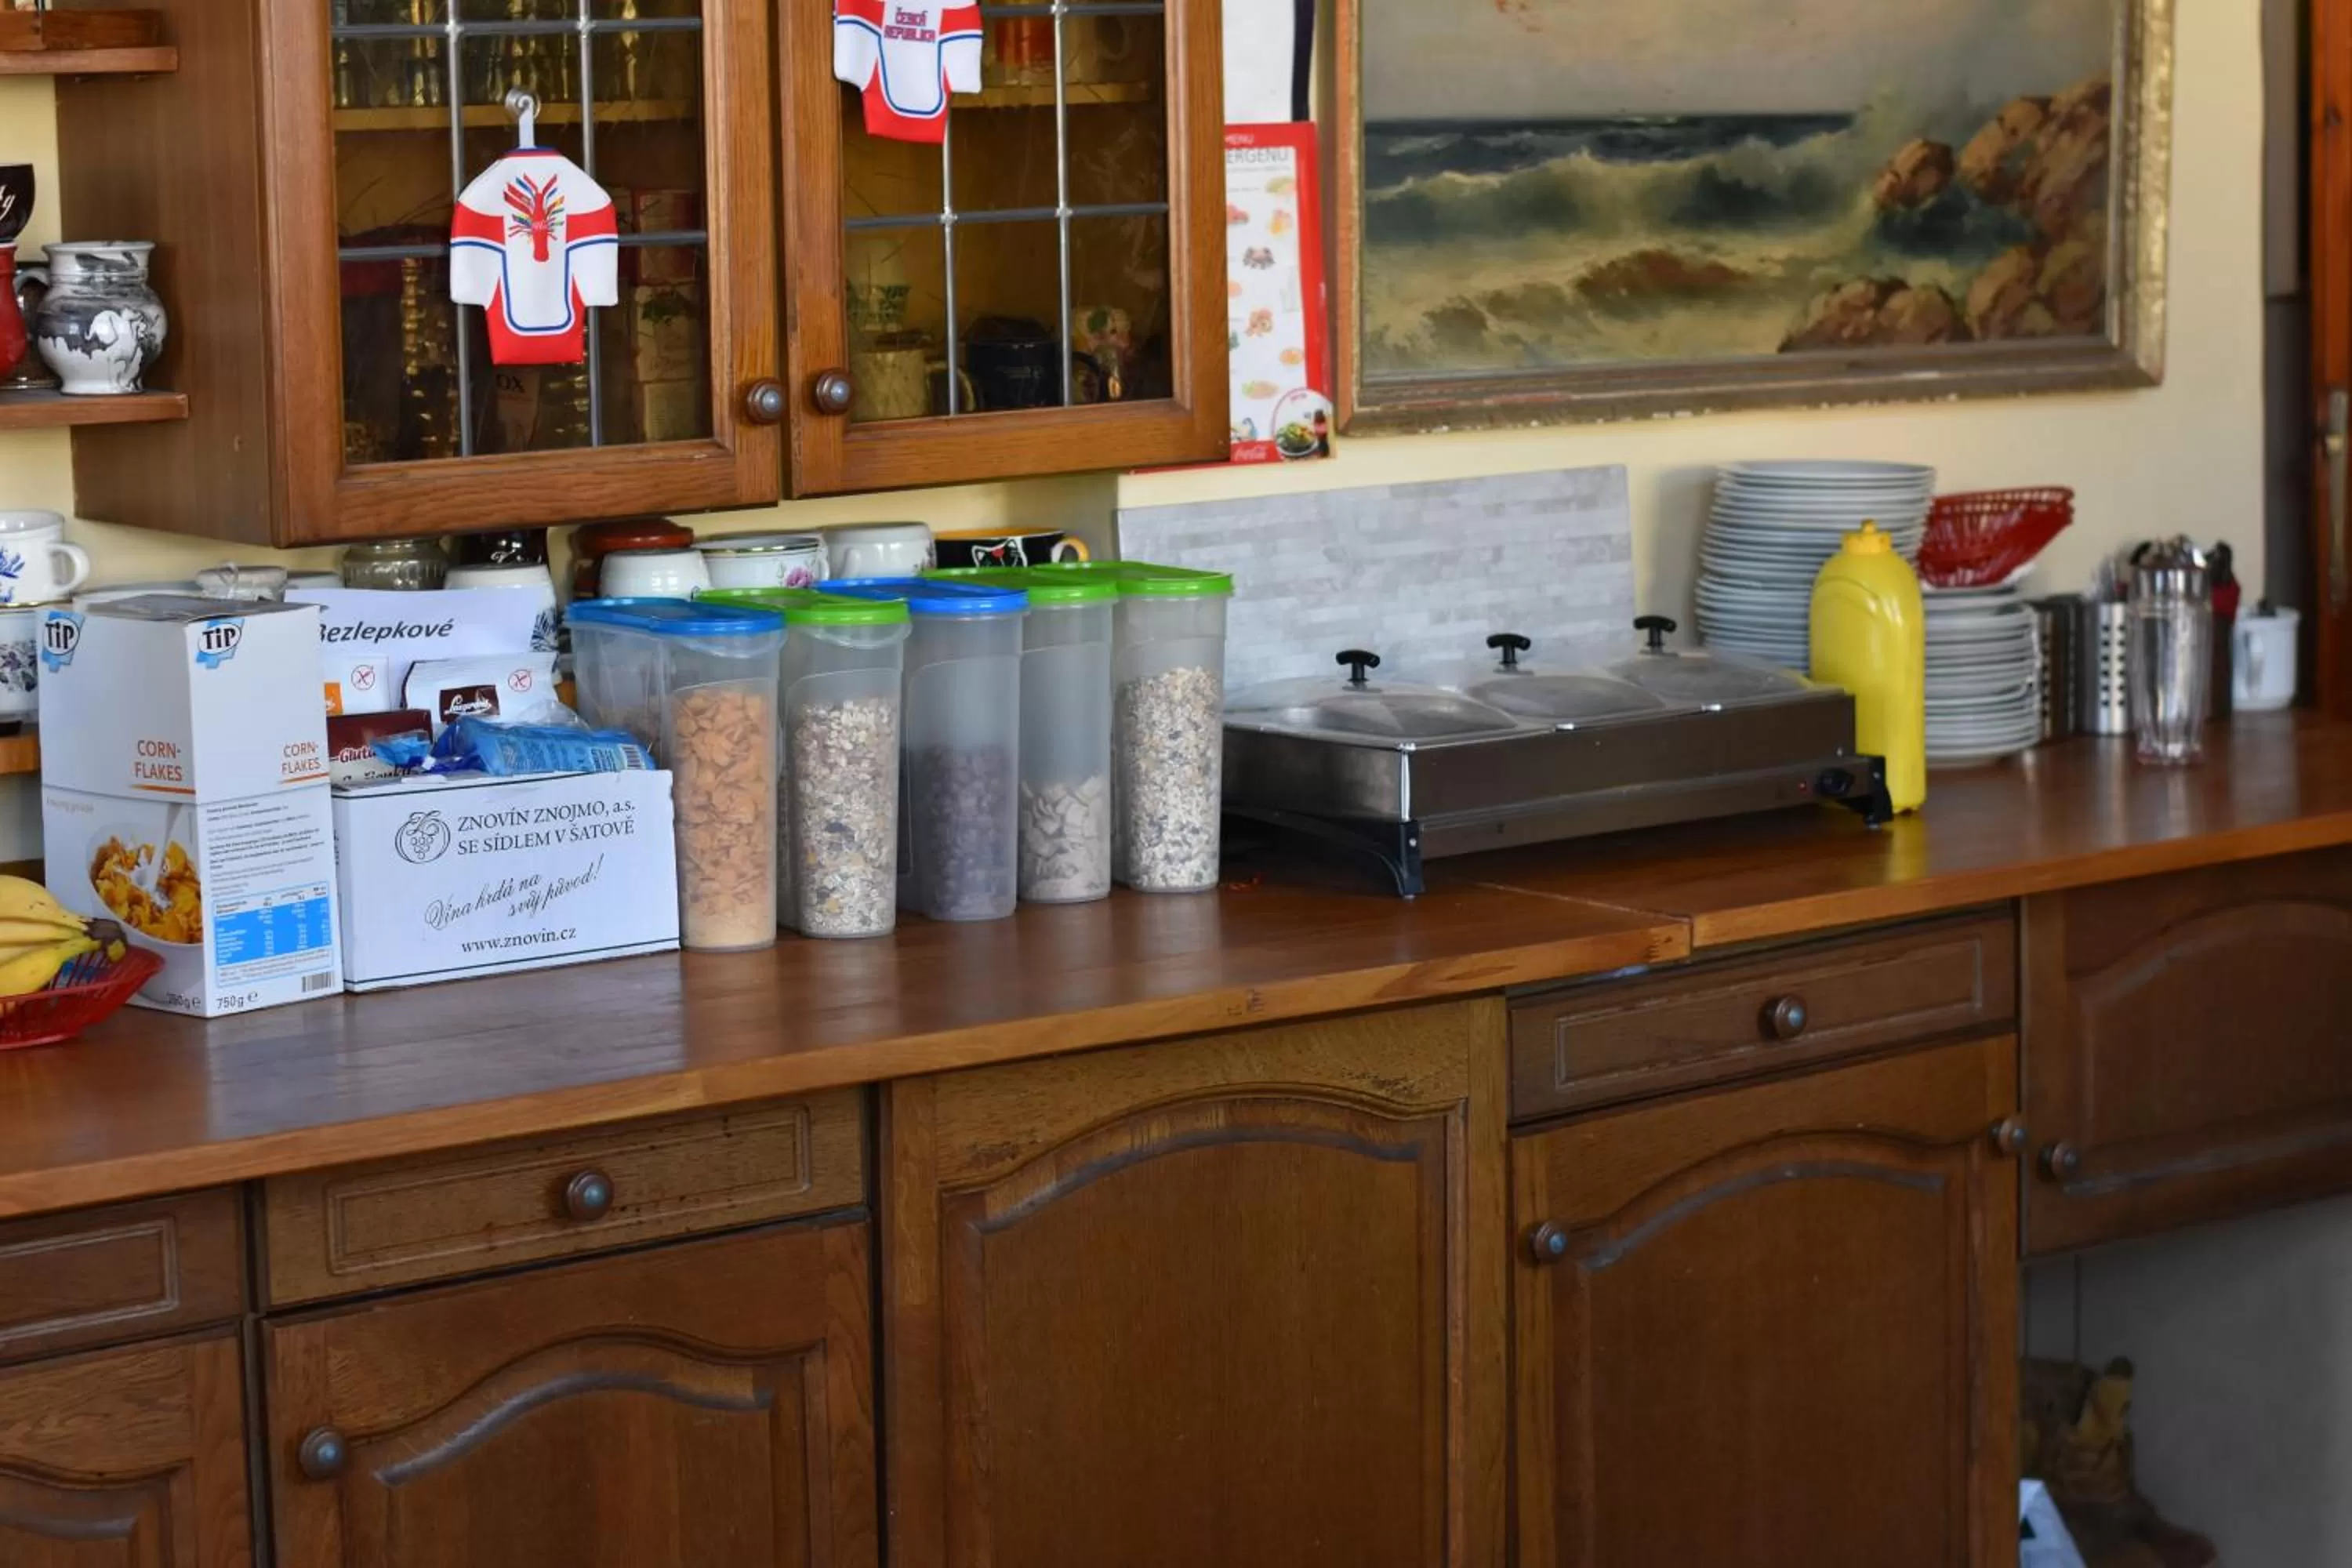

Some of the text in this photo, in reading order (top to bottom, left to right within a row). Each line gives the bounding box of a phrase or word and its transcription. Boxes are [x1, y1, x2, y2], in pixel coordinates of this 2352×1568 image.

[137, 739, 182, 759] CORN-
[134, 761, 183, 782] FLAKES
[281, 757, 321, 775] FLAKES
[458, 800, 636, 832] ZNOVÍN ZNOJMO, a.s.
[457, 815, 635, 855] SE SÍDLEM V ŠATOVĚ
[474, 877, 515, 910] hrdá
[517, 873, 542, 891] na
[461, 927, 577, 953] www.znovin.cz
